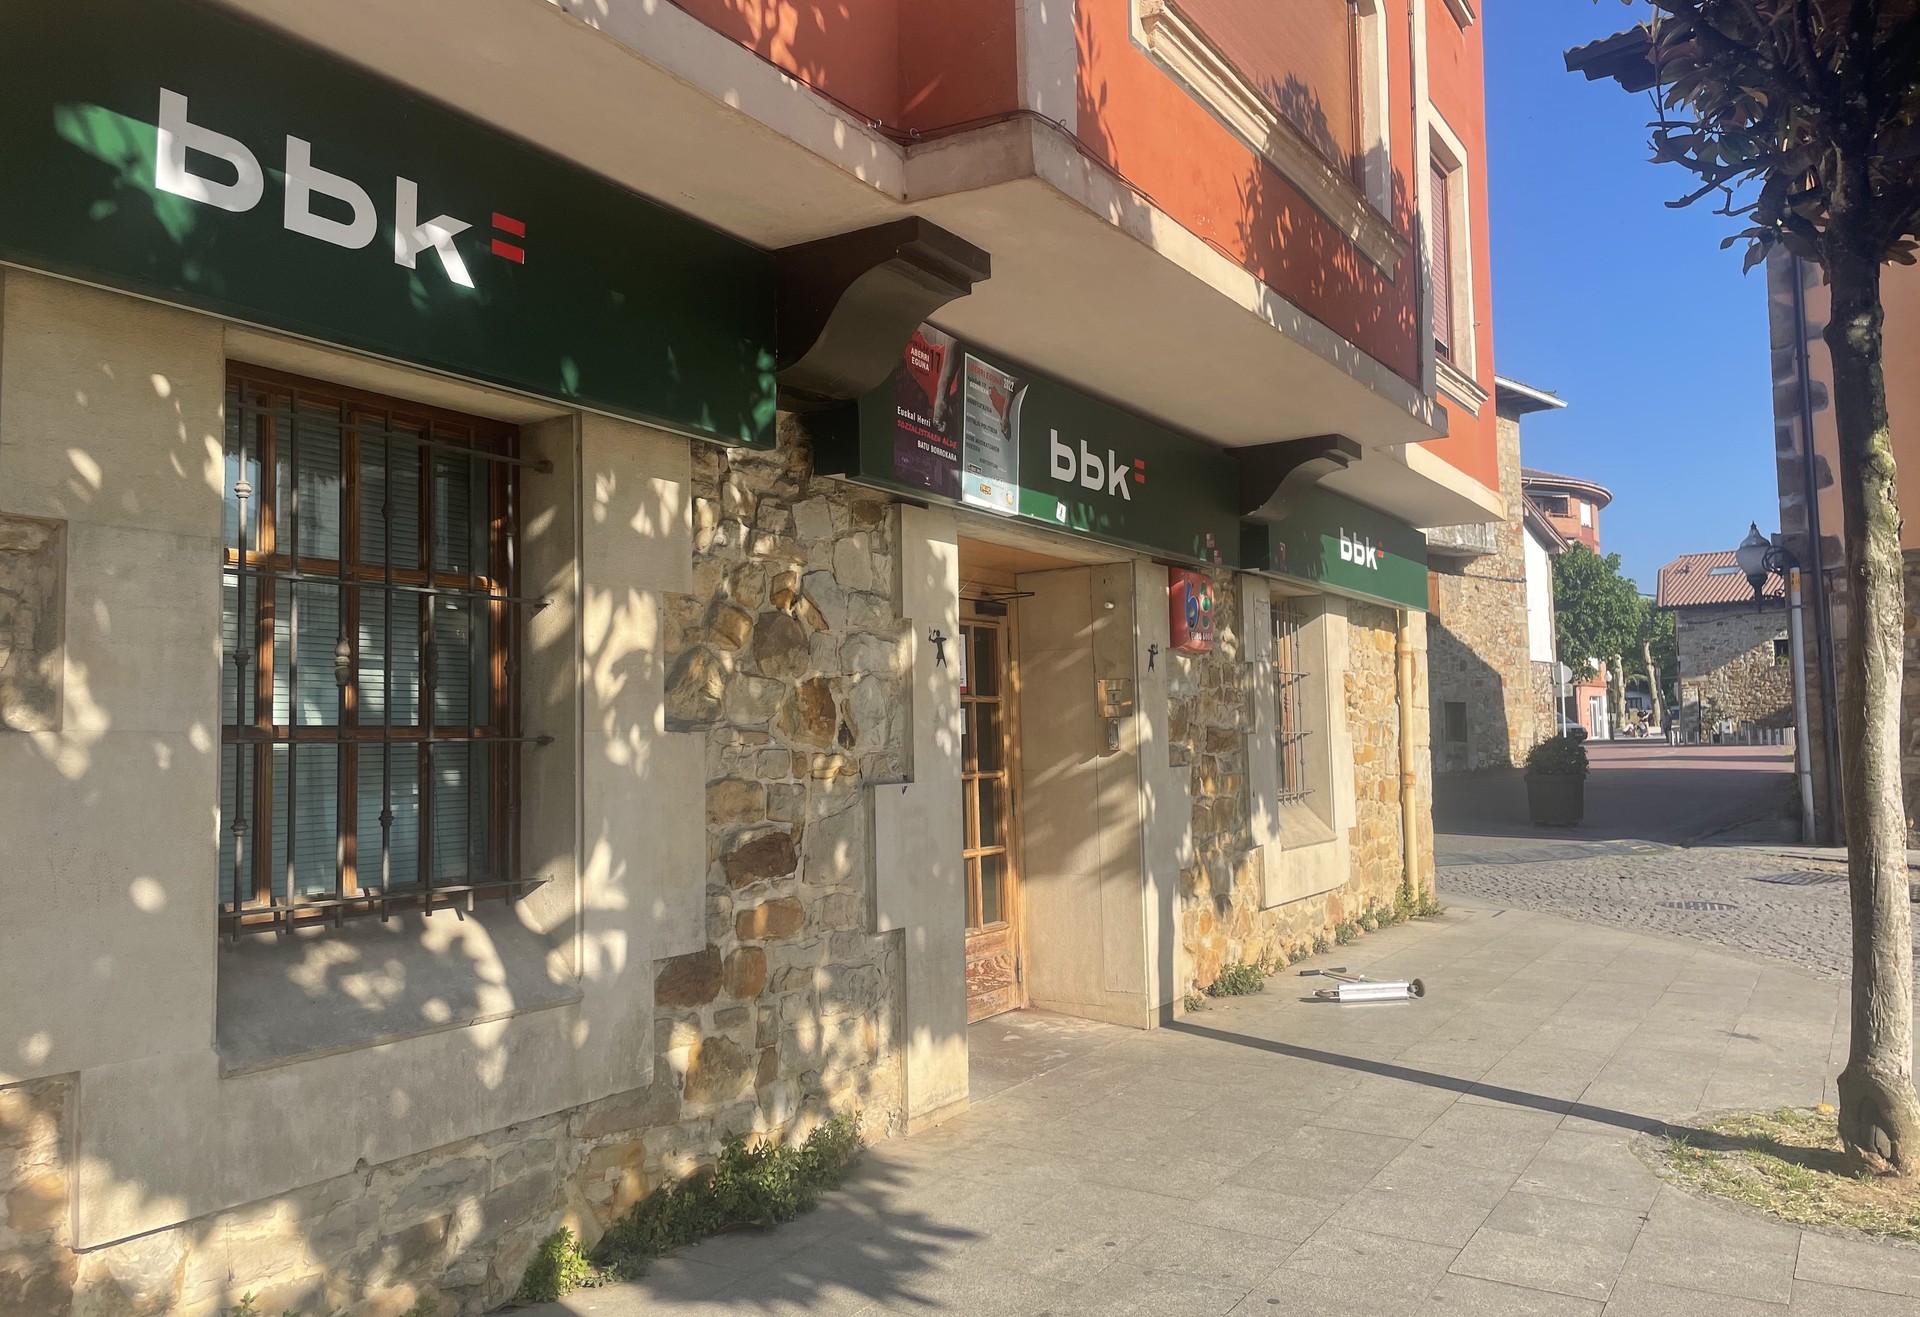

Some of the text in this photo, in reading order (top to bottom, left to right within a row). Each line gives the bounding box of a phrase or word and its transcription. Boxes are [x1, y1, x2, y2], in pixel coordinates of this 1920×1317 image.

[911, 347, 930, 363] ABERRI
[911, 356, 930, 372] EGUNA
[1003, 377, 1015, 393] 2022
[897, 405, 931, 427] Euskal Herri
[917, 440, 930, 451] BATU
[930, 445, 958, 462] BORROKARA
